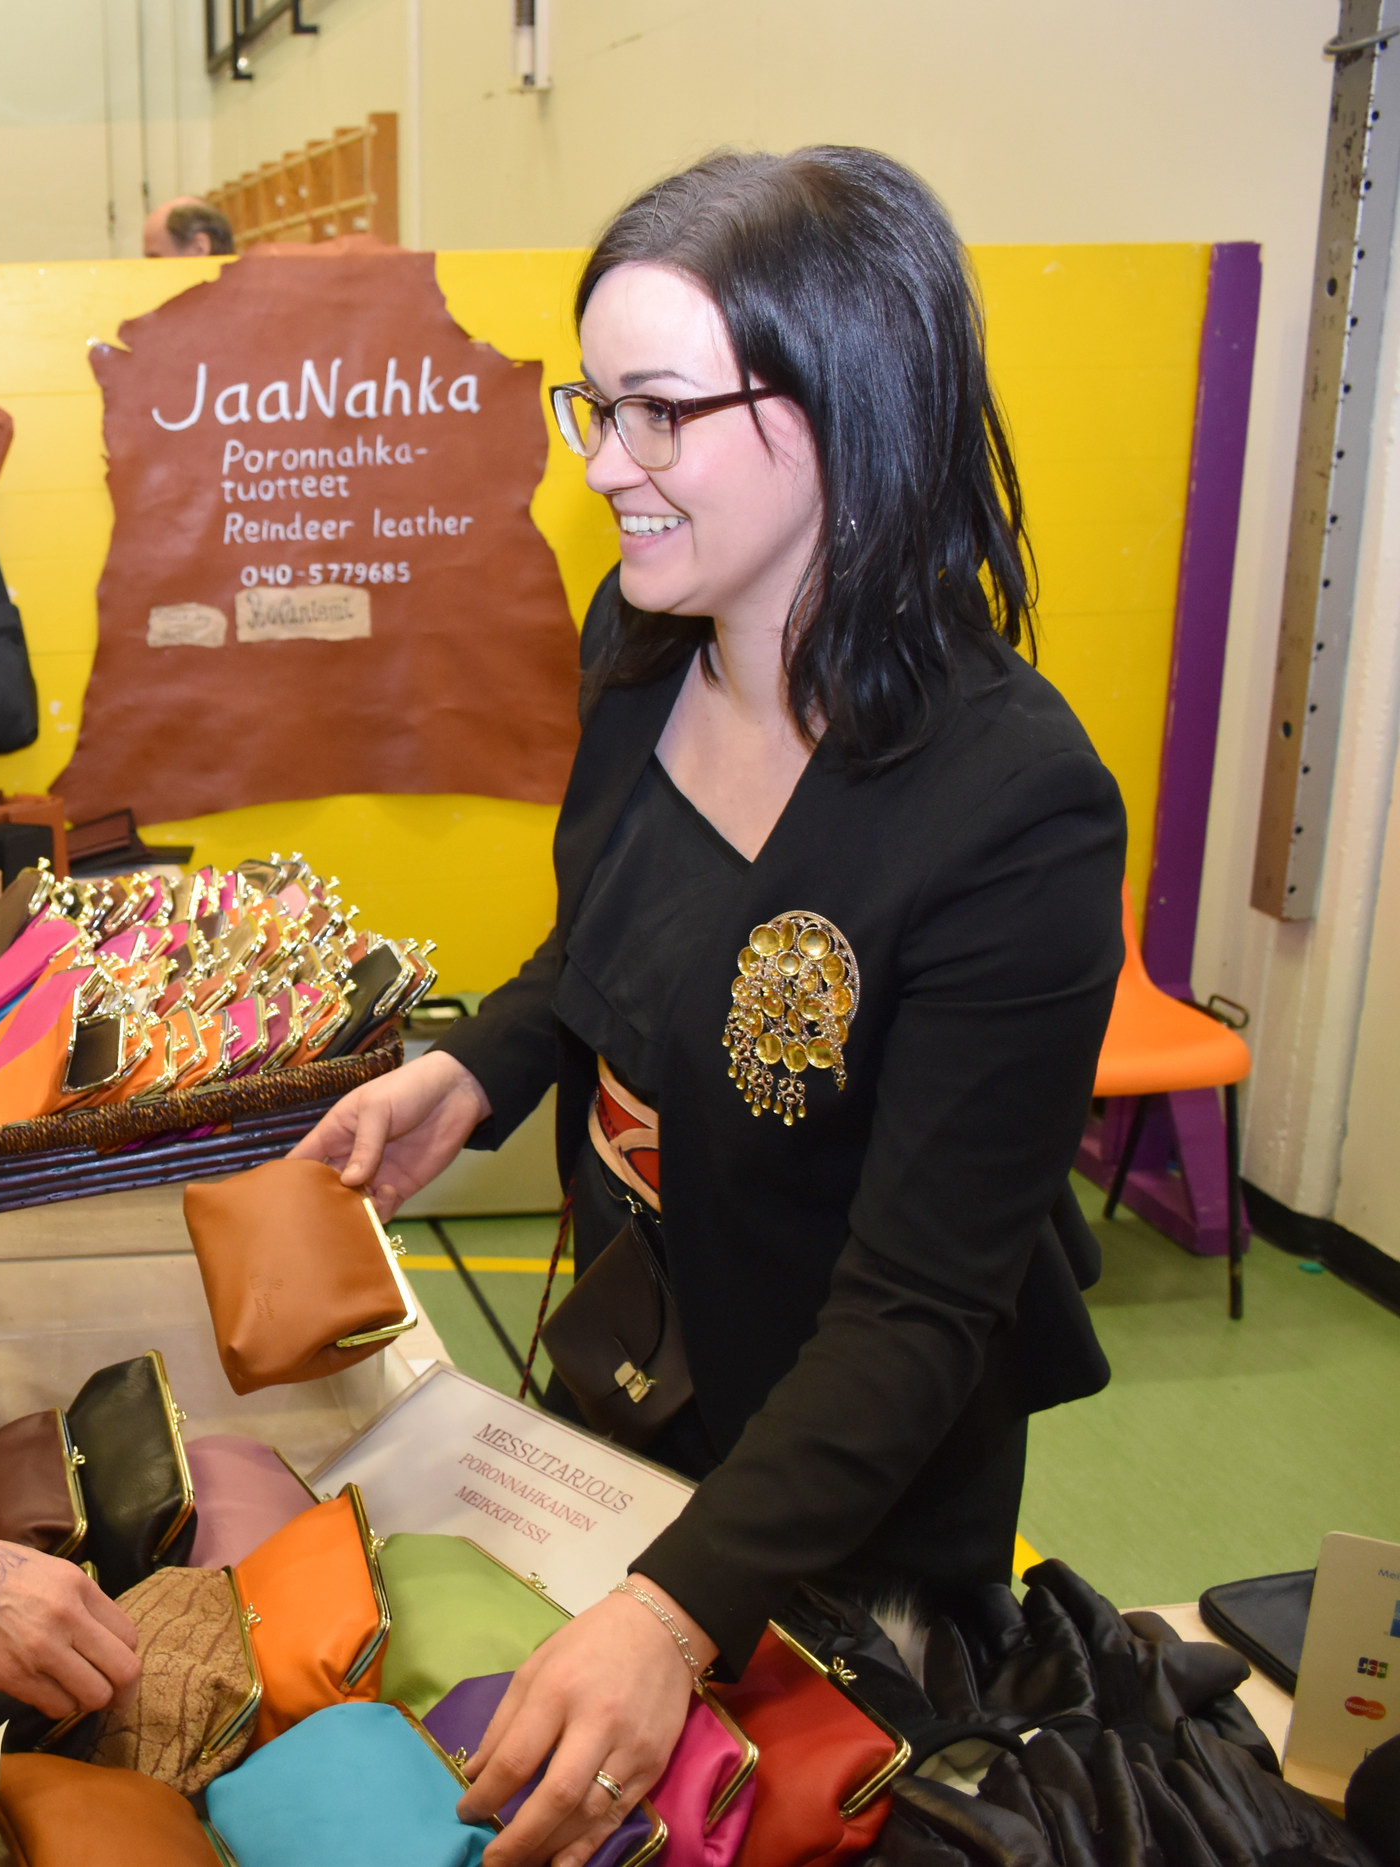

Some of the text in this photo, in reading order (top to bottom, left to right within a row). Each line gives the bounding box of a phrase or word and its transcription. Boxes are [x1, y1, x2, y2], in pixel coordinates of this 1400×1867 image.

[151, 356, 481, 431] JaaNahka
[221, 435, 429, 476] Poronnahka-
[221, 474, 350, 504] tuotteet
[223, 506, 475, 545] Reindeer leather
[240, 561, 412, 587] 040-5779685
[458, 1453, 596, 1532] PORONNAHKAINEN
[475, 1423, 635, 1513] MESSUTARJOUS
[455, 1485, 551, 1544] MEIKKIPUSSI
